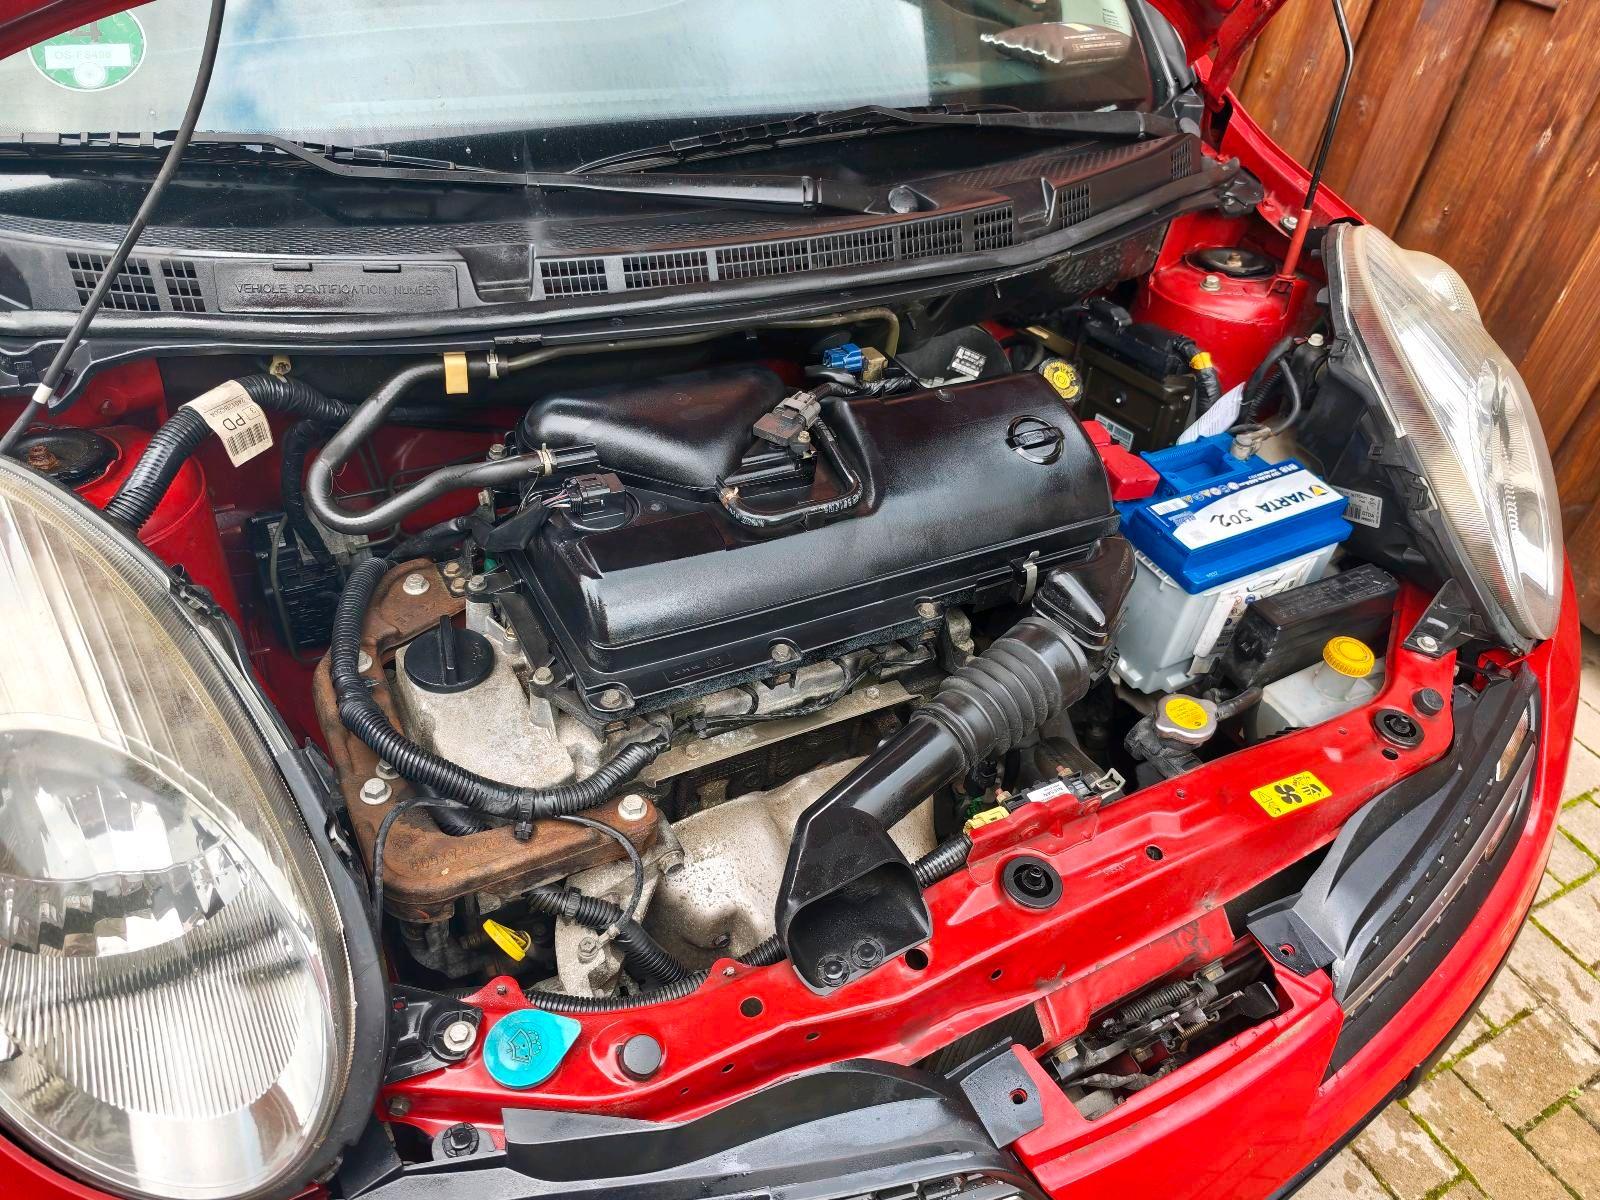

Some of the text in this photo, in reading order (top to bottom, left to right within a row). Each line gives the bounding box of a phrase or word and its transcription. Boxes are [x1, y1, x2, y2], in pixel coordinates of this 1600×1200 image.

[234, 283, 441, 296] VEHICLE IDENTIFICATION NUMBER
[222, 413, 246, 431] PD
[1256, 489, 1313, 513] VARTA
[1209, 508, 1254, 528] 502
